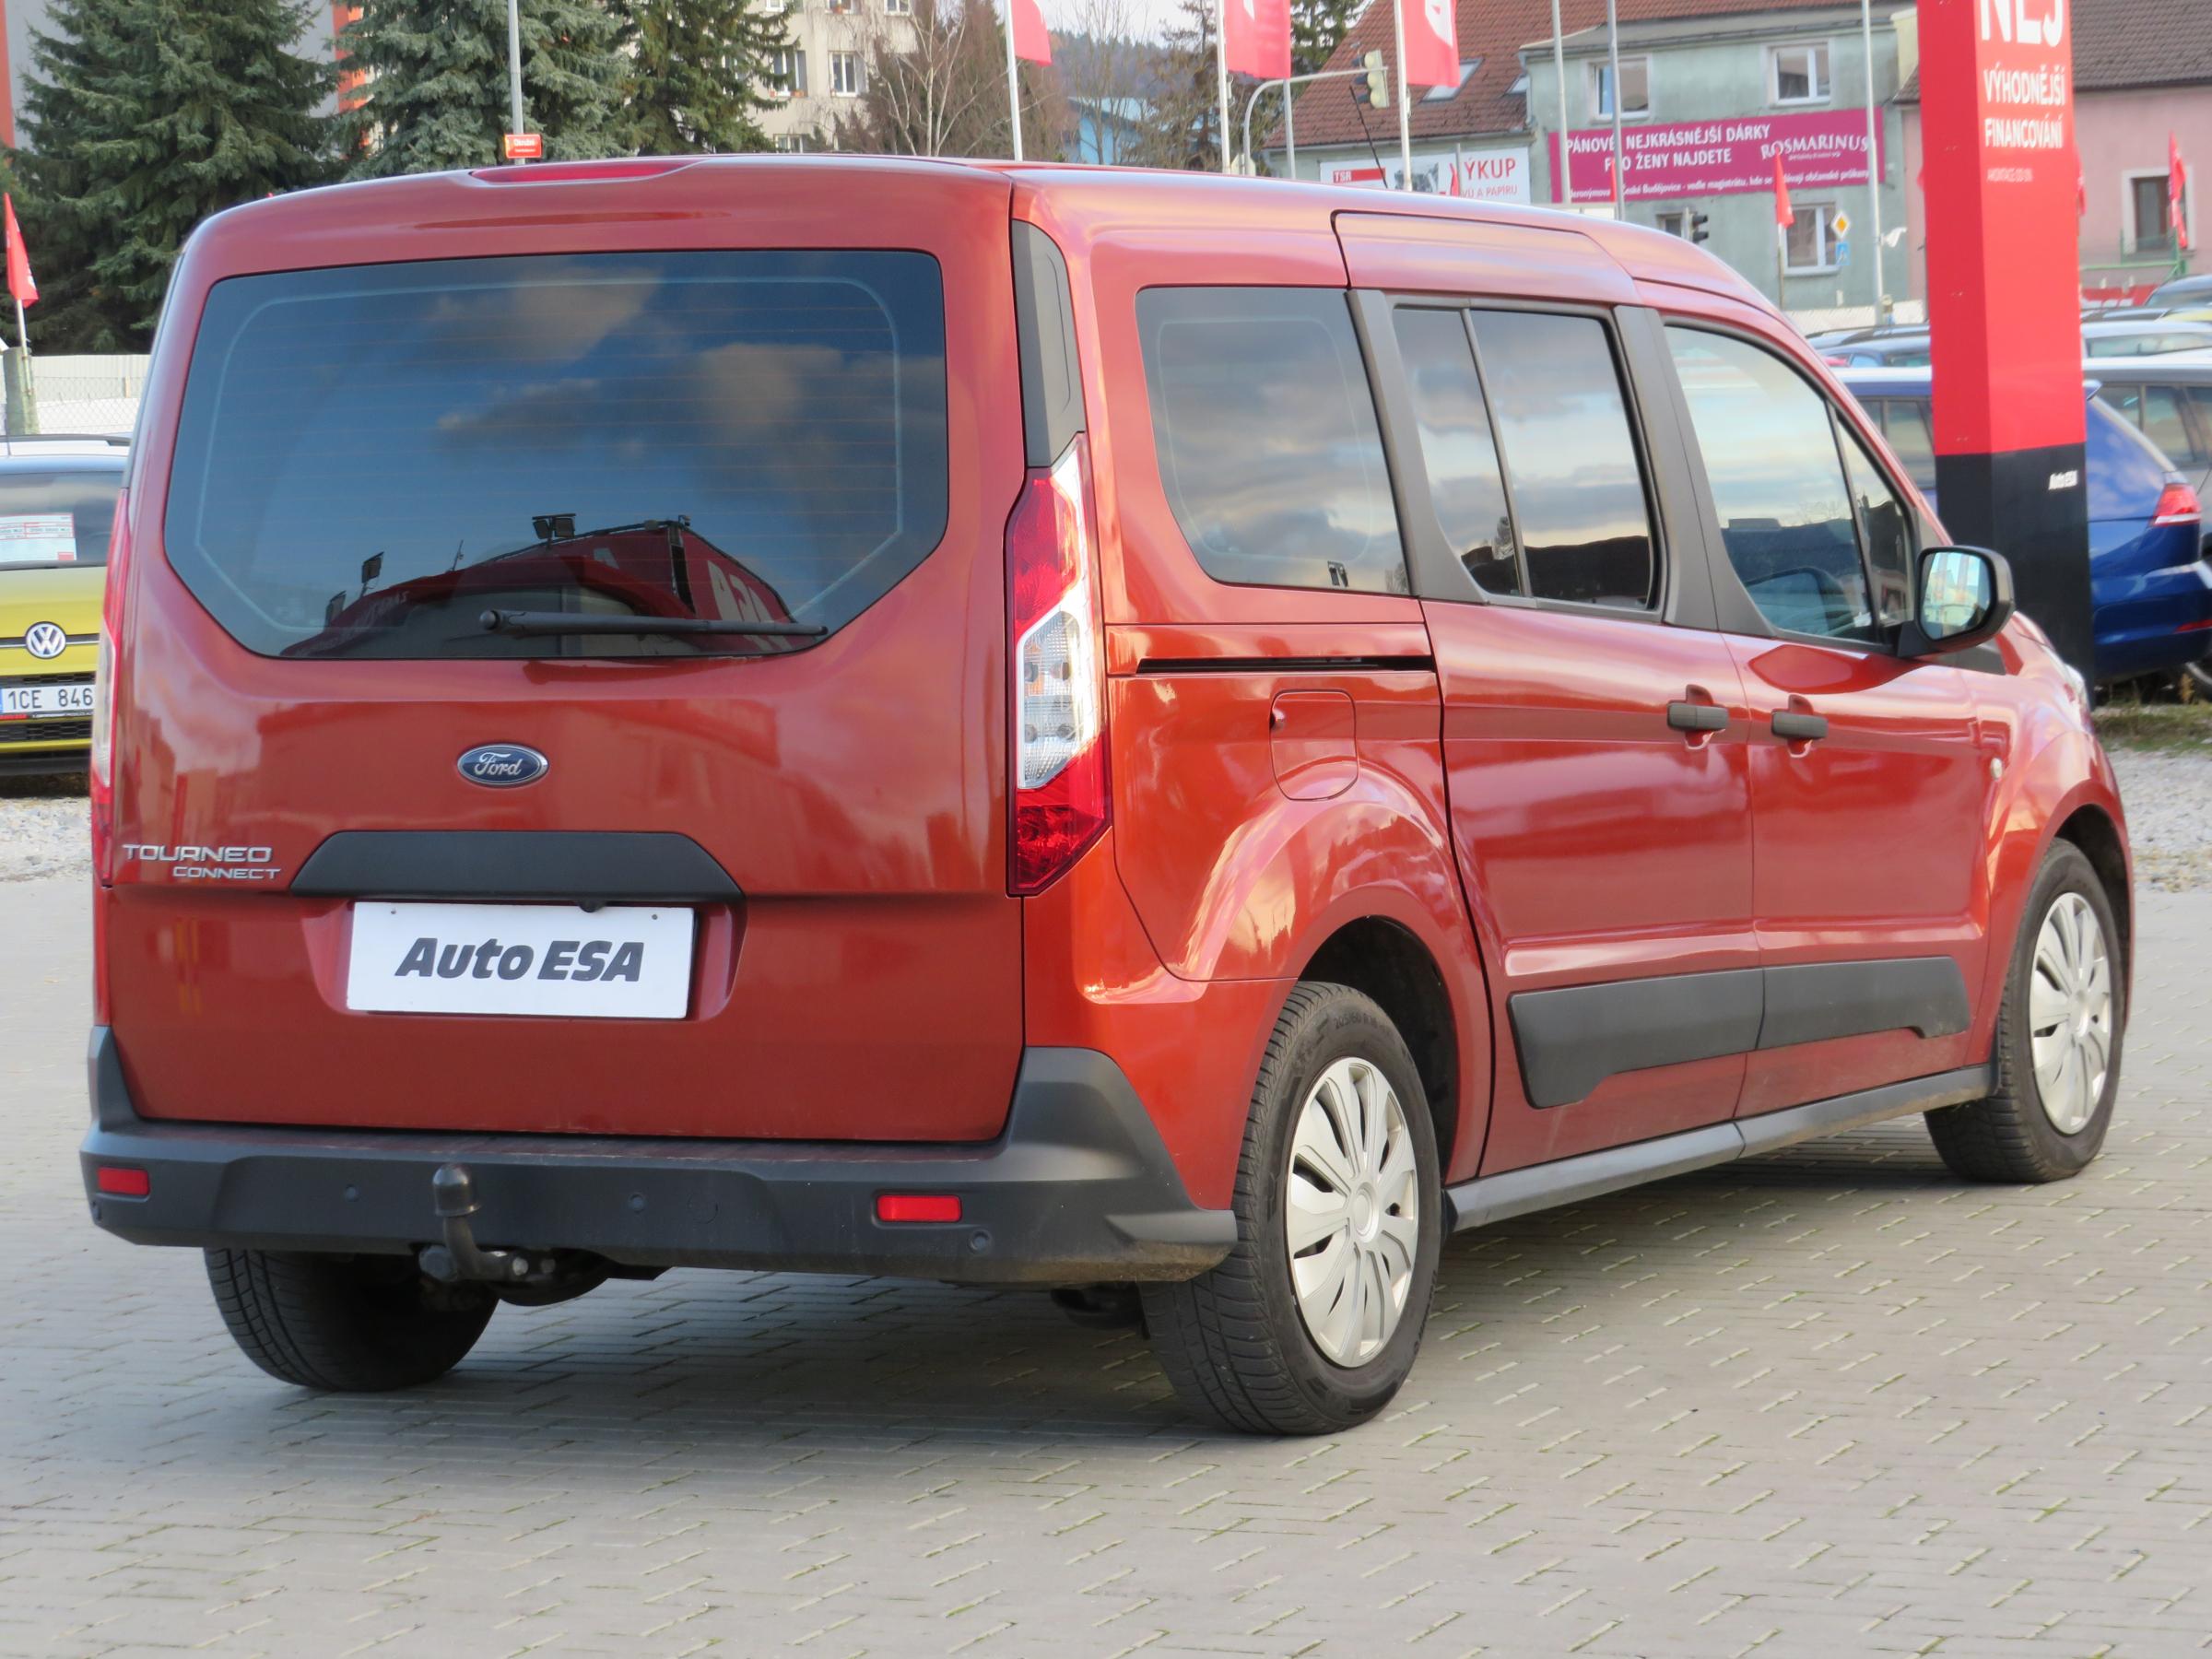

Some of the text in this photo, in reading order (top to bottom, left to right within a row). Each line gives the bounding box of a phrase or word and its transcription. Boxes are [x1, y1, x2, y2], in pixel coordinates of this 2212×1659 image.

[1983, 62, 2065, 105] VÝHODNĚJŠÍ
[1626, 125, 1722, 150] NEJKRÁSNĚJŠÍ
[1726, 123, 1771, 142] DÁRKY
[1984, 112, 2064, 148] FINANCOVÁNÍ
[1760, 133, 1869, 159] ROSMARINUS
[1635, 150, 1670, 171] ŽENY
[1673, 147, 1732, 167] NAJDETE
[7, 689, 42, 711] 1CE
[474, 751, 524, 775] Ford
[122, 843, 273, 863] TOURNEO
[172, 865, 281, 880] CONNECT
[394, 936, 644, 982] Auto ESA
